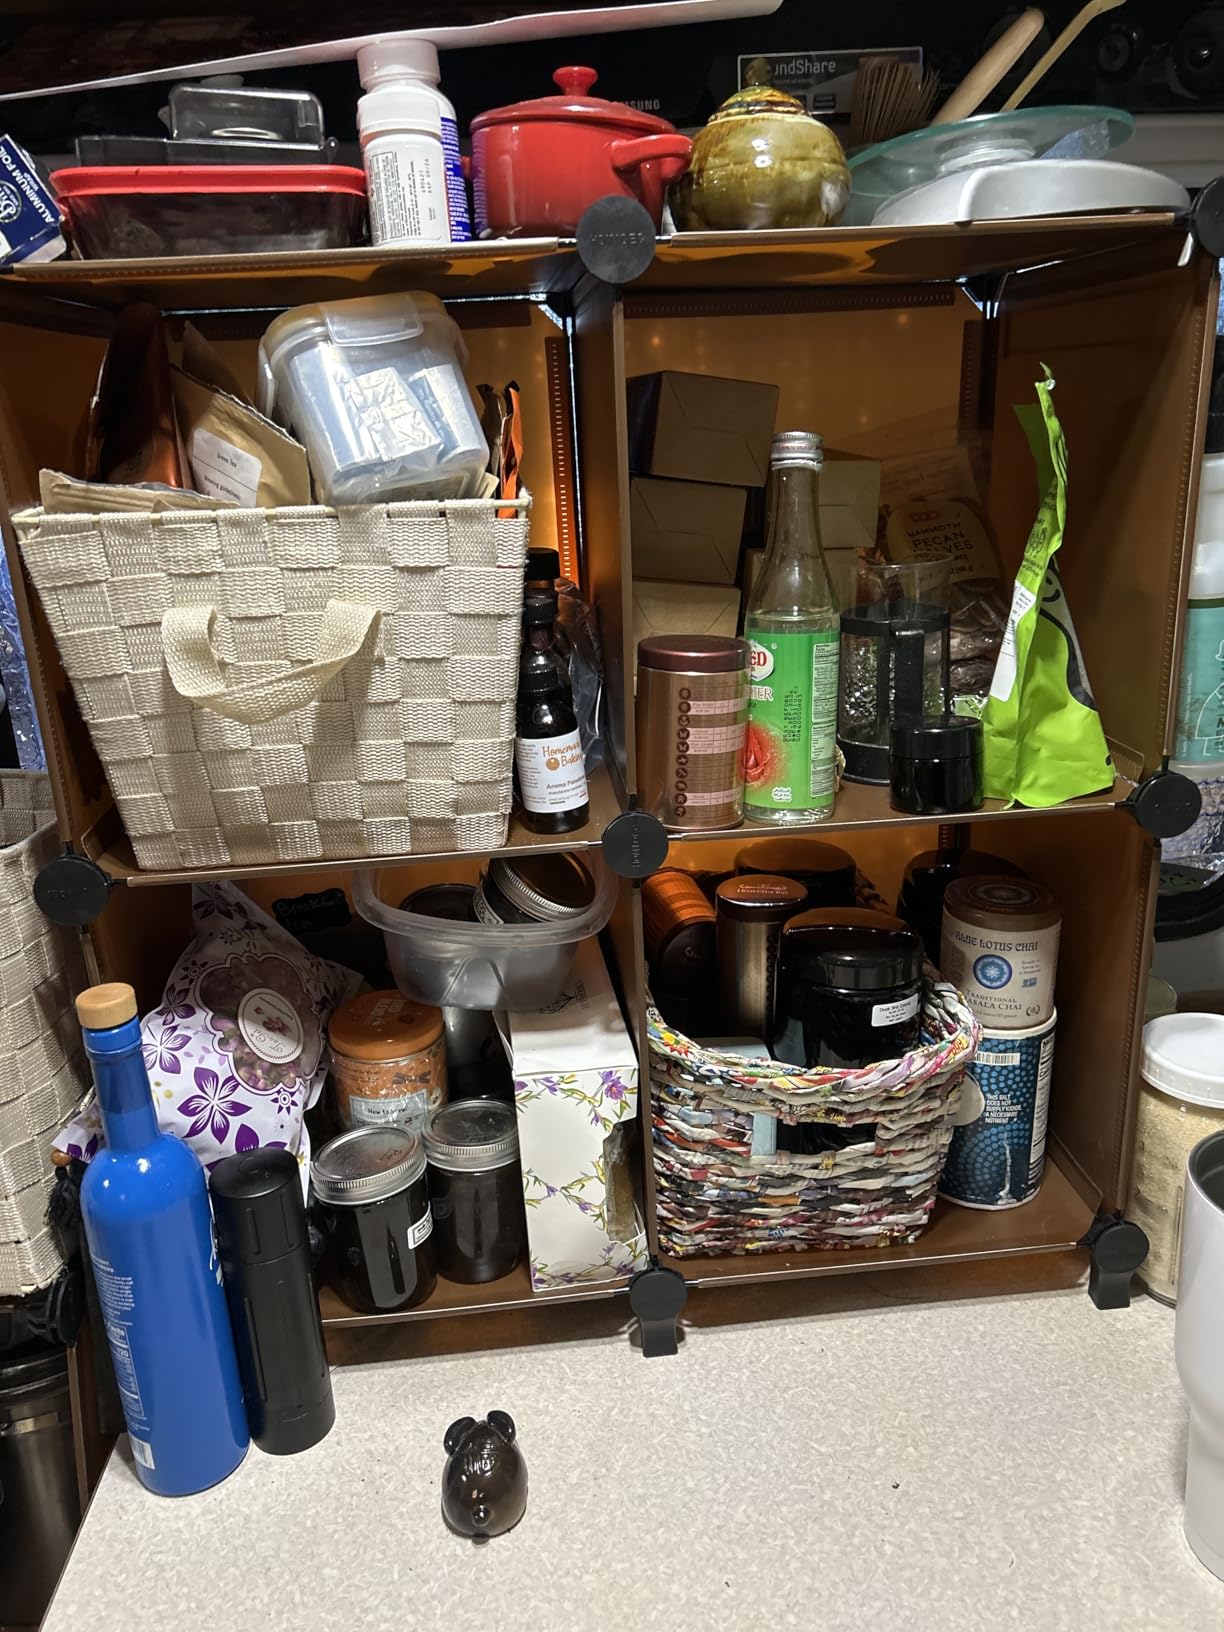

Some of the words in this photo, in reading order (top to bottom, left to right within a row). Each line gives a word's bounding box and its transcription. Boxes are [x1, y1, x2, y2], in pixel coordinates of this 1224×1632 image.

[0, 145, 17, 171] FOIL
[12, 167, 56, 224] ALUMINUM
[911, 530, 965, 549] PECAN
[751, 686, 773, 701] TER
[955, 931, 977, 947] BLUE
[979, 939, 1013, 952] LOTUS
[1014, 941, 1039, 952] CHAI
[964, 996, 996, 1010] ASALA
[966, 989, 1017, 1003] TRADITIONAL
